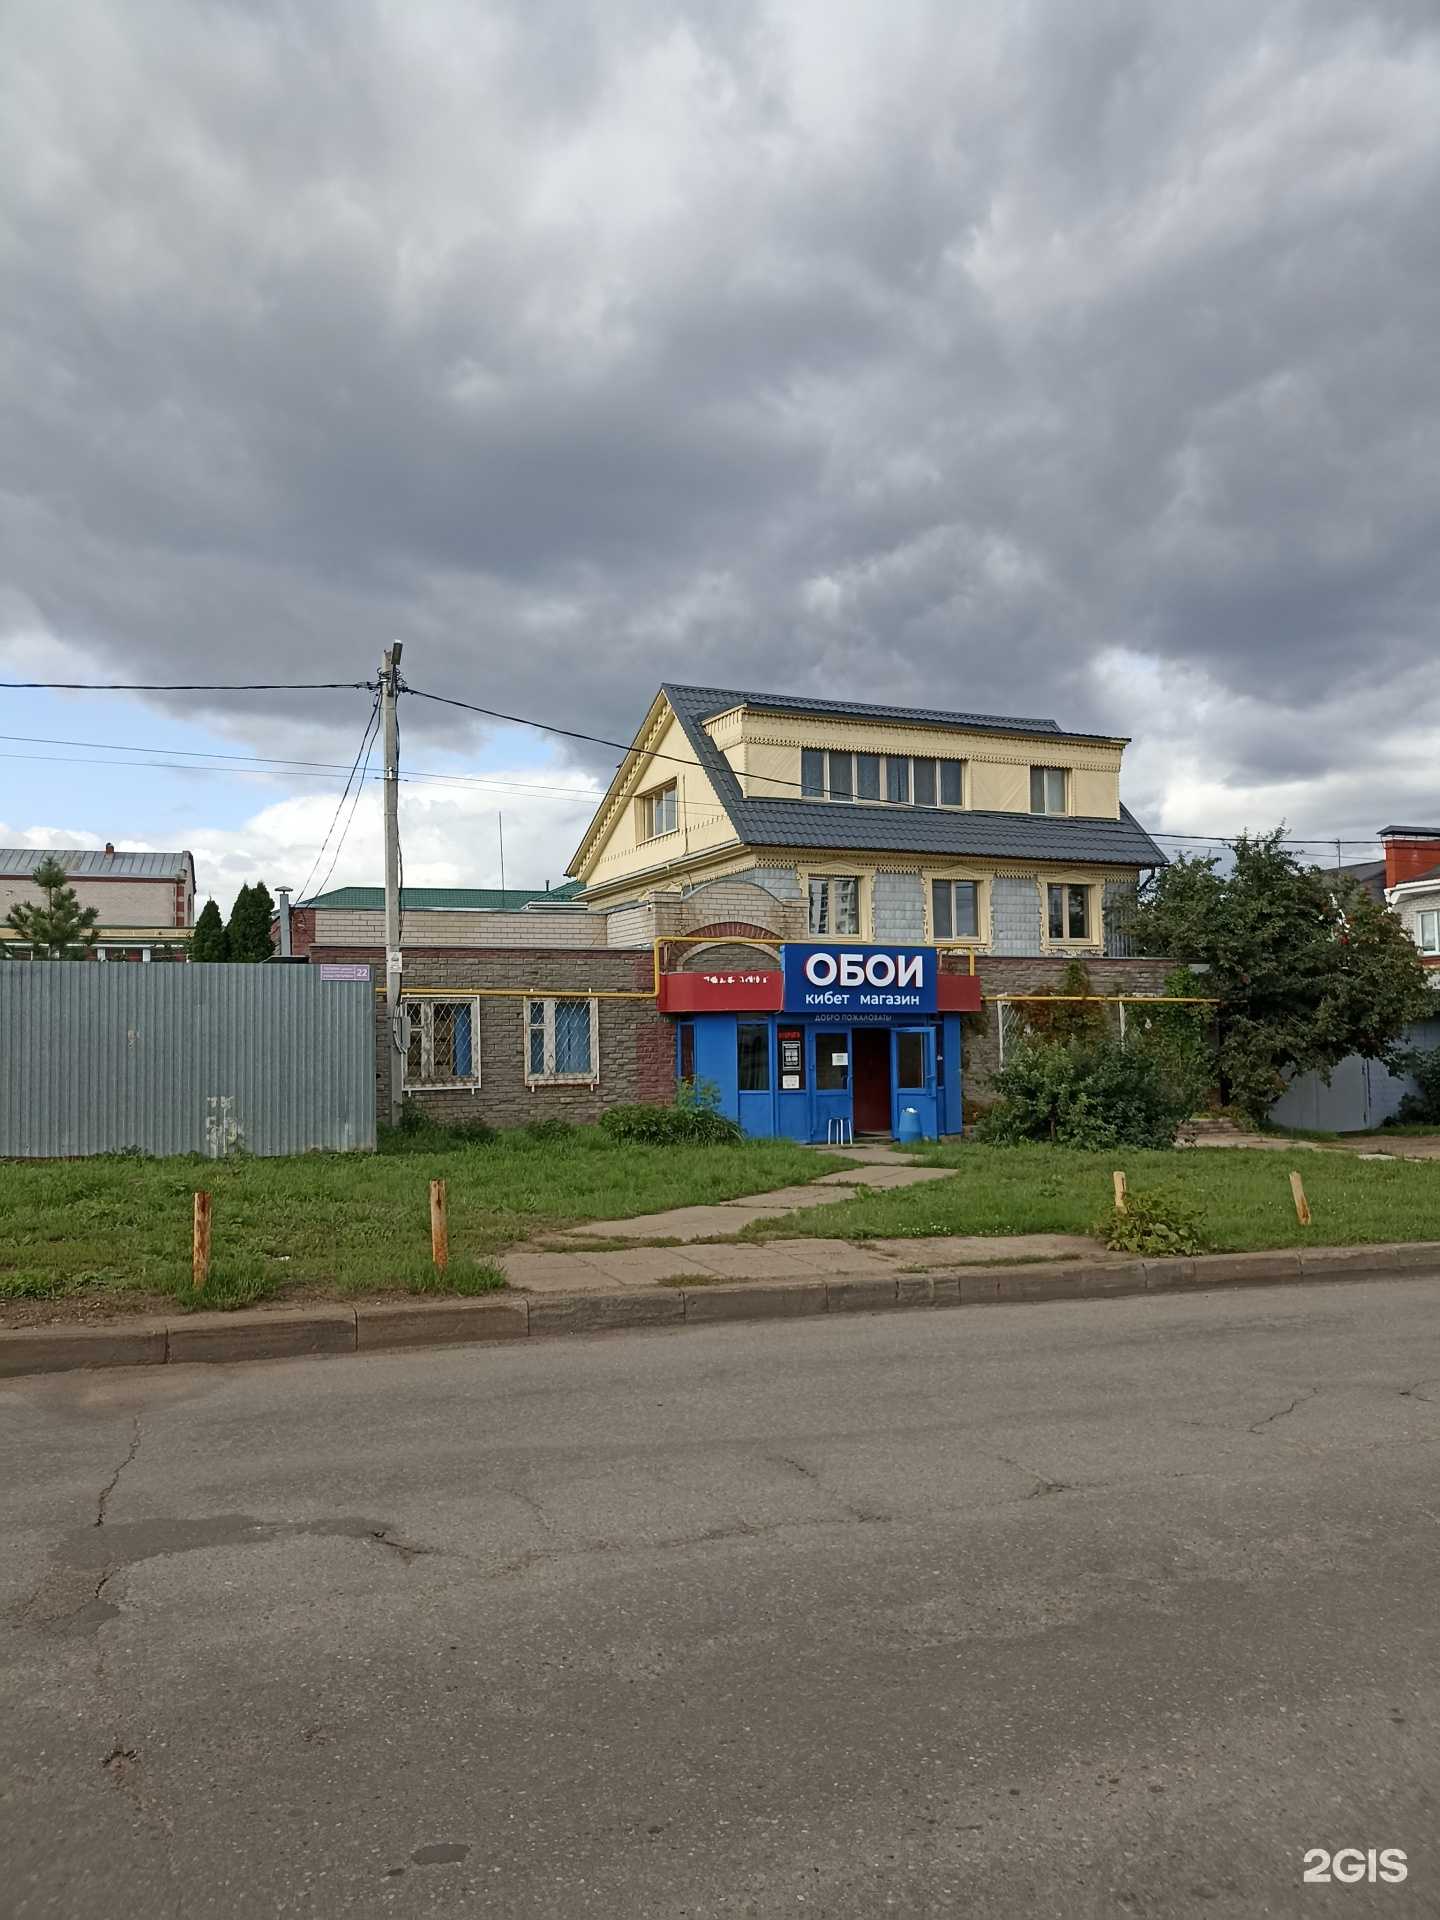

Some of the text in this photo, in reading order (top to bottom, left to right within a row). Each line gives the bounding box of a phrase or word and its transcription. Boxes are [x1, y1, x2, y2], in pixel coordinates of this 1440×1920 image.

[356, 968, 368, 977] 22
[804, 952, 924, 988] ОБОИ
[805, 991, 920, 1006] кибет магазин
[814, 1014, 840, 1022] ДОБРО
